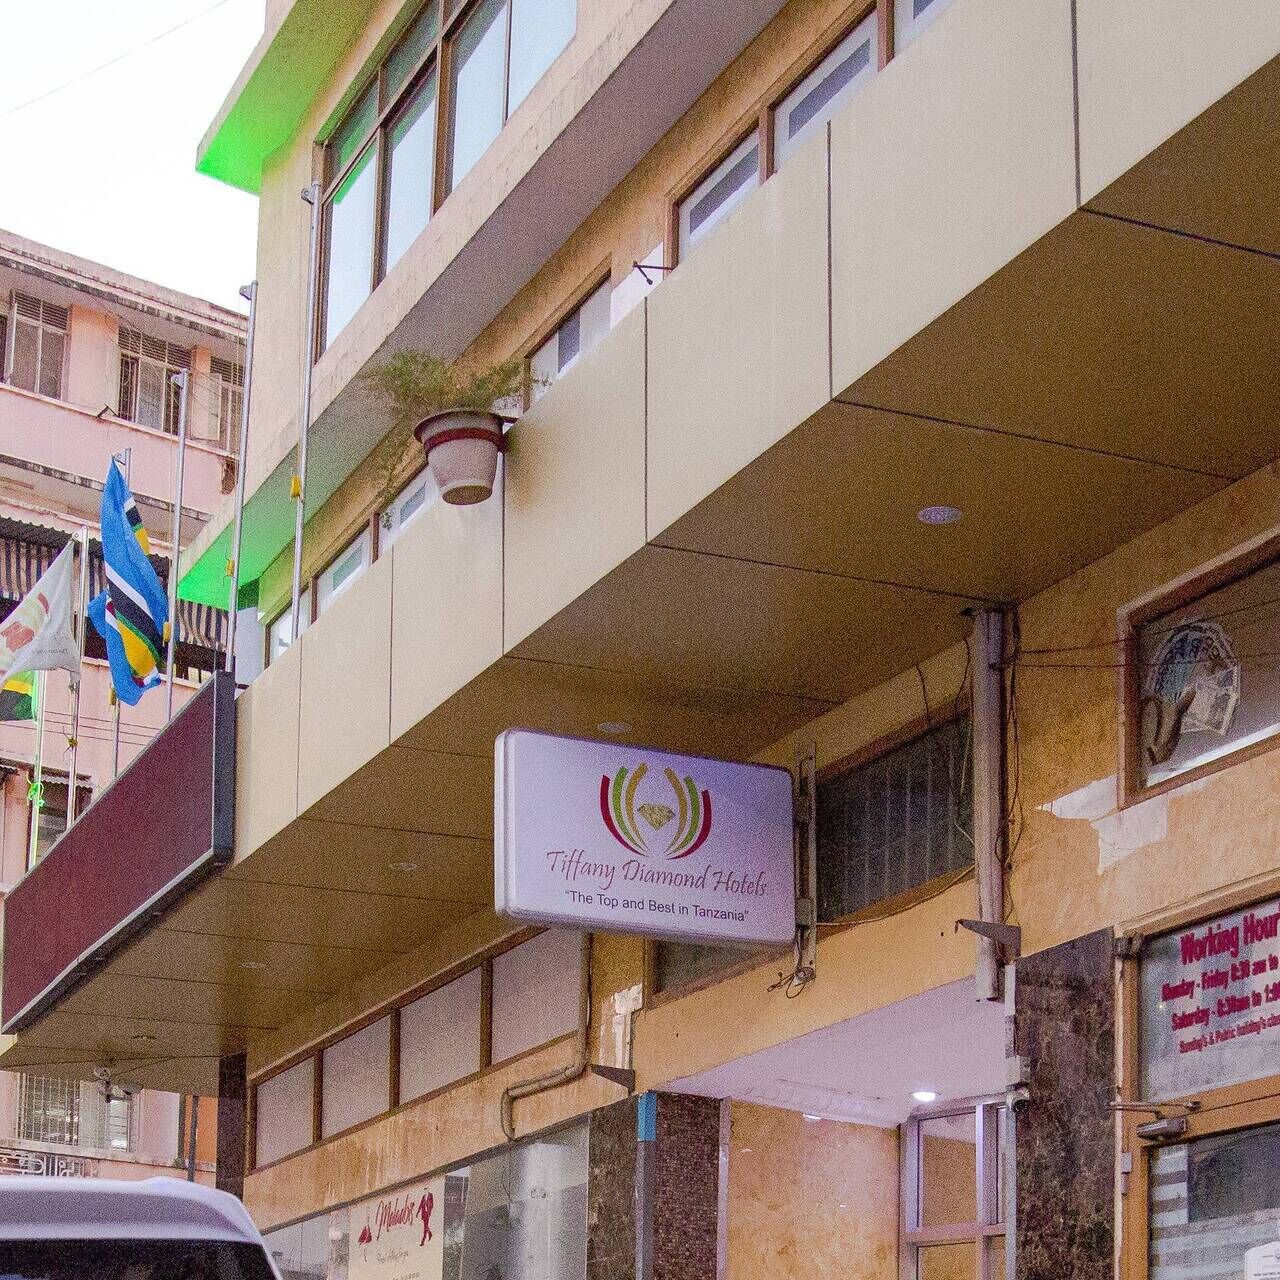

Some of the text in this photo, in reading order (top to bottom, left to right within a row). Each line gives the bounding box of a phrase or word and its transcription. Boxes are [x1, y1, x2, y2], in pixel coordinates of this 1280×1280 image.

[546, 848, 768, 897] Tiffany Diamond Hotels
[597, 893, 619, 910] Top
[622, 898, 644, 911] and
[648, 899, 675, 914] Best
[678, 904, 689, 915] in
[1180, 924, 1240, 966] Working
